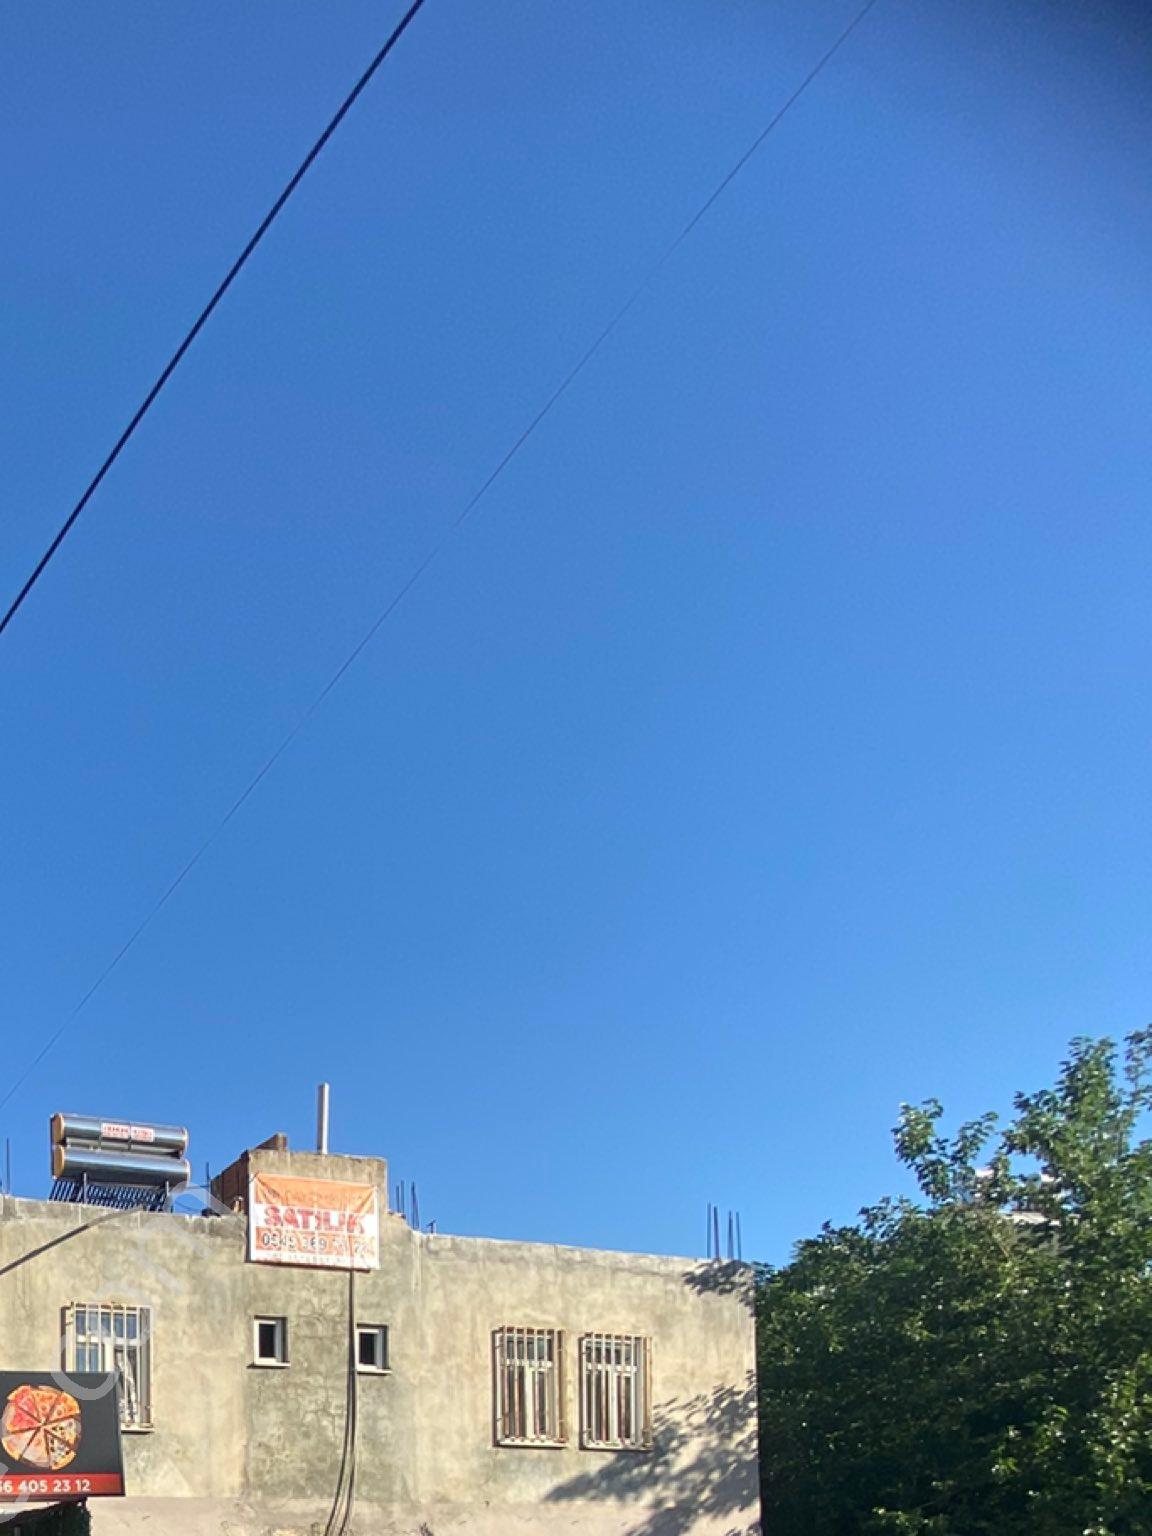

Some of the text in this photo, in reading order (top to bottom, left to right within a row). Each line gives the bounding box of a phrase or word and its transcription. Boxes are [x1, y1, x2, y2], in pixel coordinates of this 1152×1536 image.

[18, 1478, 48, 1492] 405
[53, 1478, 71, 1492] 23
[75, 1478, 91, 1492] 12
